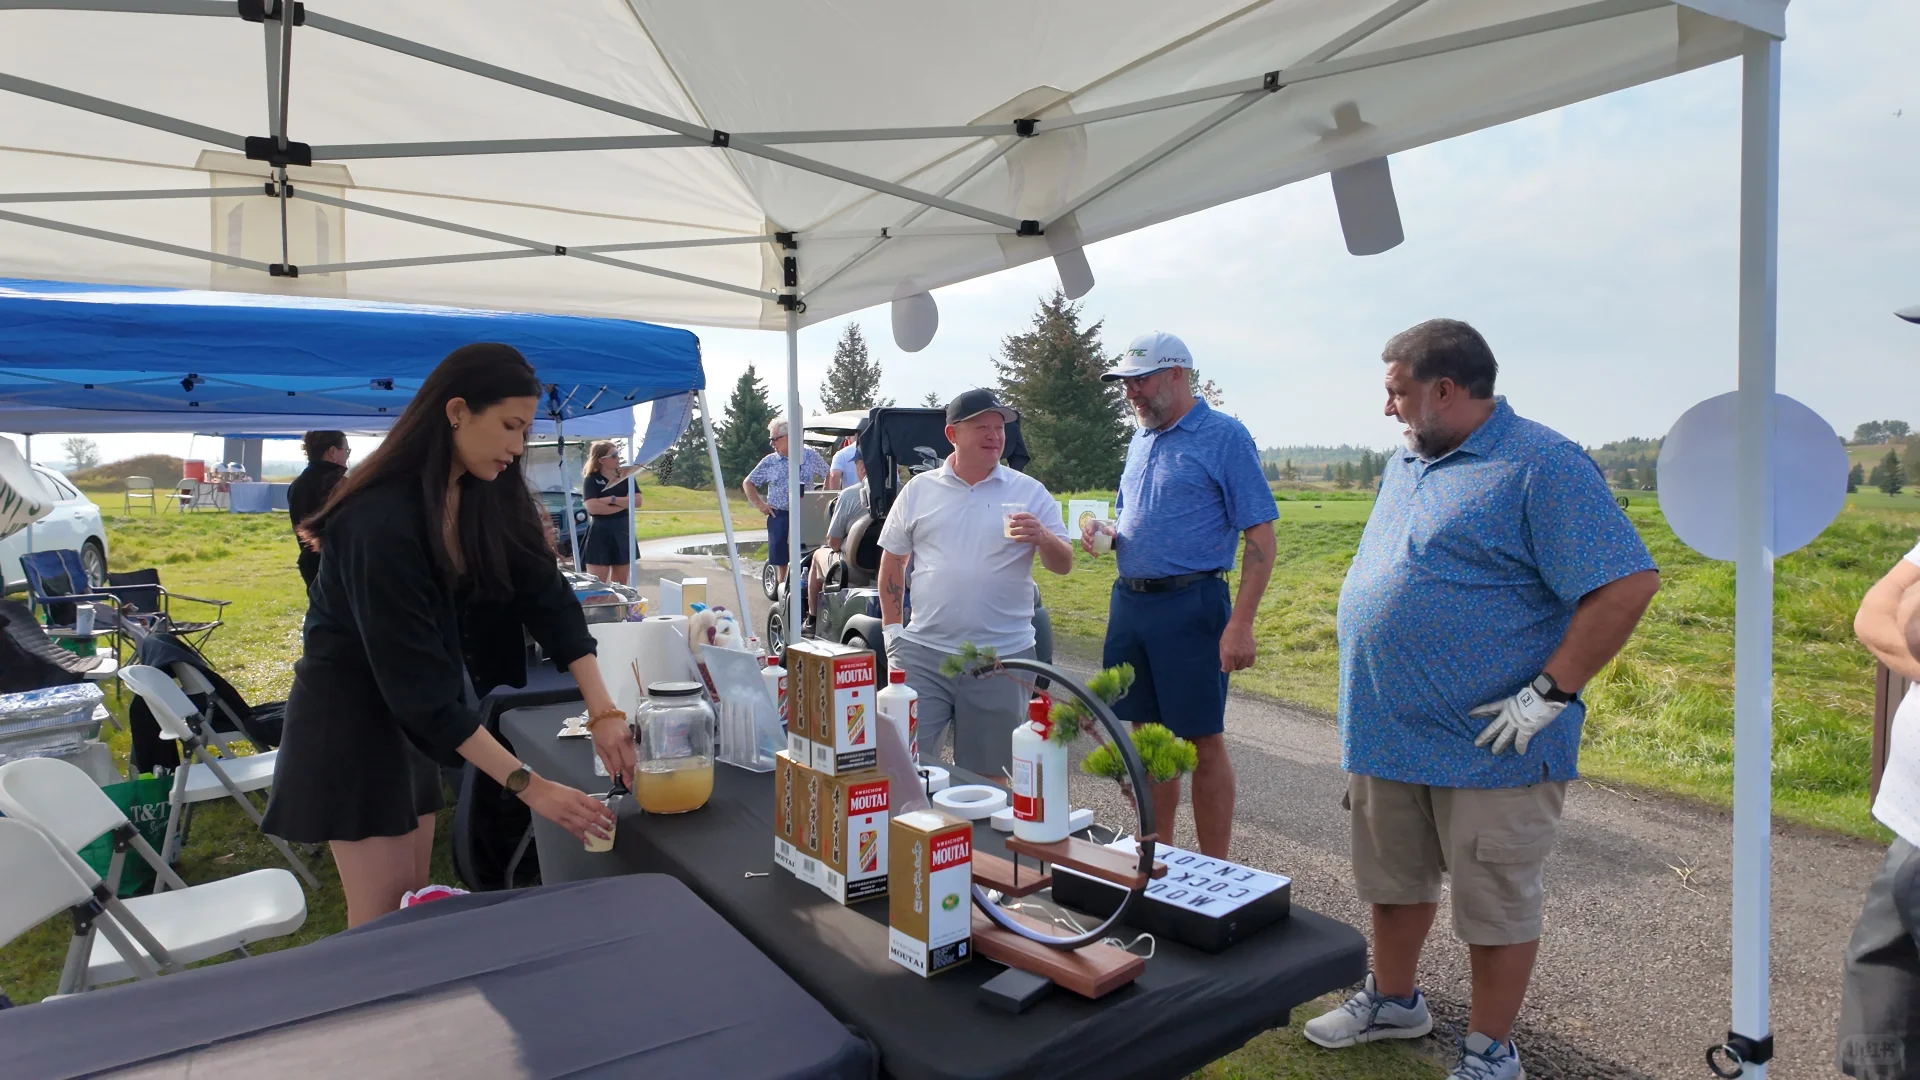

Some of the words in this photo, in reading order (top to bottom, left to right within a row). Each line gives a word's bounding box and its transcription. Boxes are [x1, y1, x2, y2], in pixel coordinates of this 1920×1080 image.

[1157, 356, 1187, 364] APEX
[836, 667, 873, 685] MOUTAI
[130, 801, 169, 823] T&T
[850, 792, 887, 811] MOUTAI
[932, 841, 969, 867] MOUTAI
[1154, 851, 1257, 882] ENJOY
[1167, 868, 1250, 899] COCK
[890, 946, 924, 969] MOUTAI
